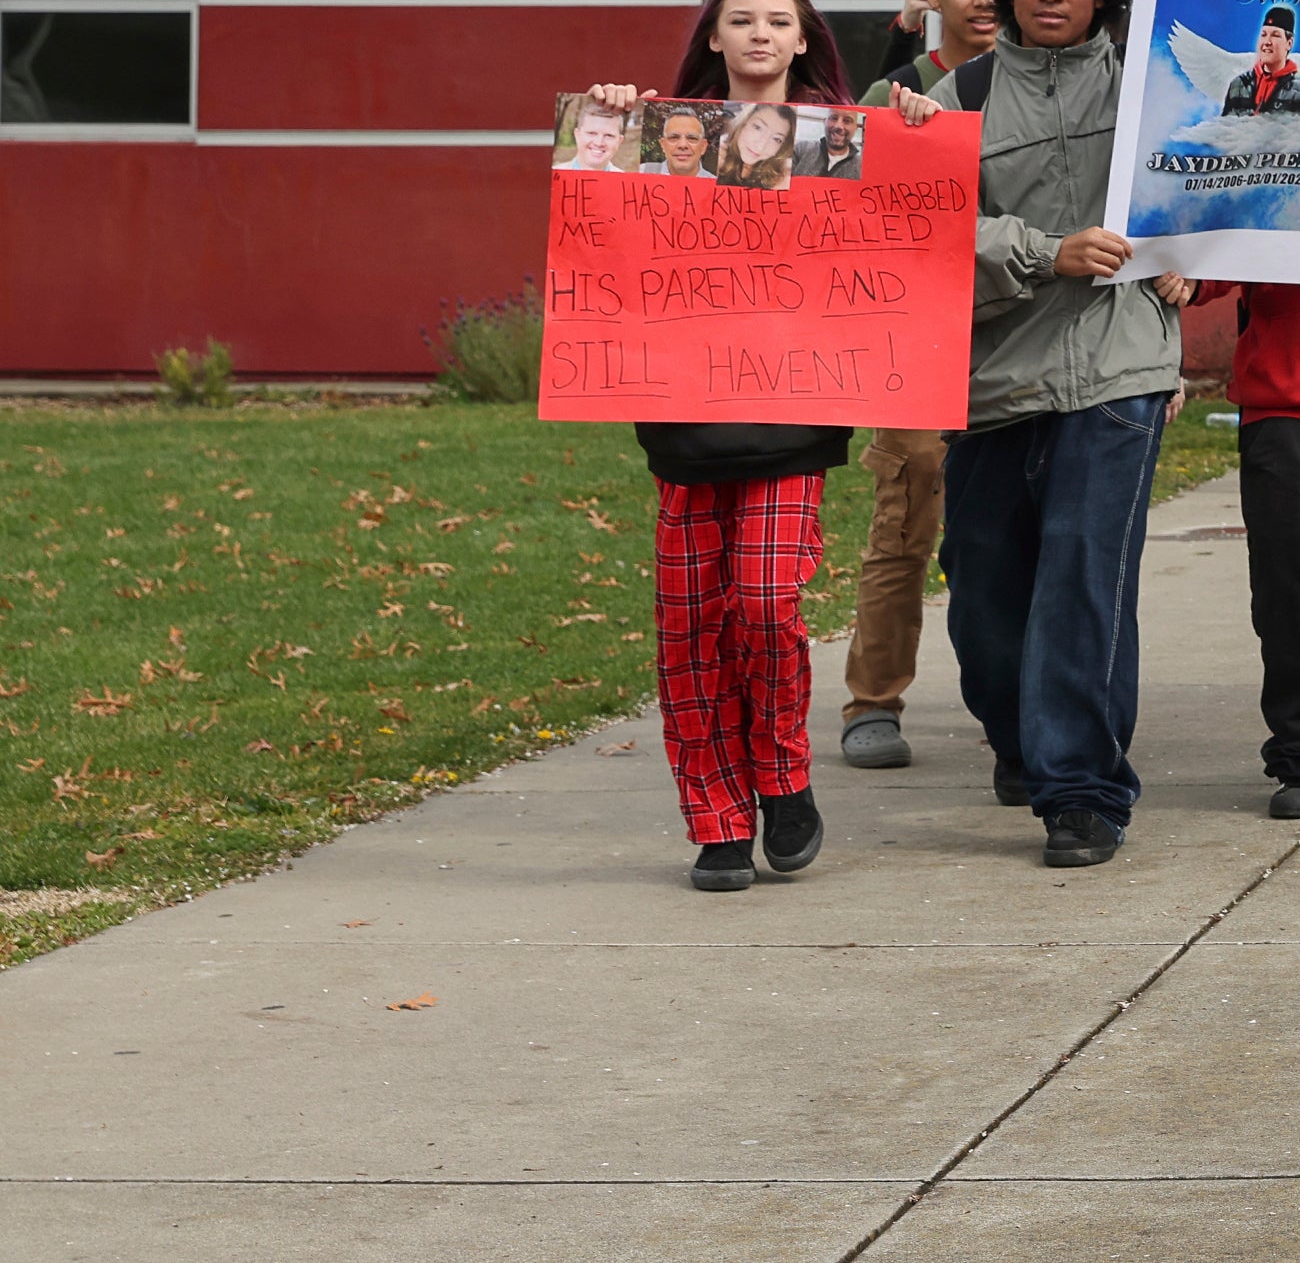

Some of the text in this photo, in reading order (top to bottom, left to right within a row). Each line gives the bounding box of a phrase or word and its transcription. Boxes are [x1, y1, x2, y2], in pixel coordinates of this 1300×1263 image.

[1147, 153, 1251, 173] JAYDEN
[622, 181, 670, 220] HAS
[682, 186, 696, 216] A
[711, 186, 792, 216] KNIFE
[812, 189, 846, 214] HE
[860, 178, 967, 215] STABBED
[652, 216, 778, 252] NOBODY
[797, 213, 933, 247] CALLED
[552, 263, 907, 316] HIS PARENTS AND
[552, 340, 669, 391] STILL
[706, 344, 870, 394] HAVENT
